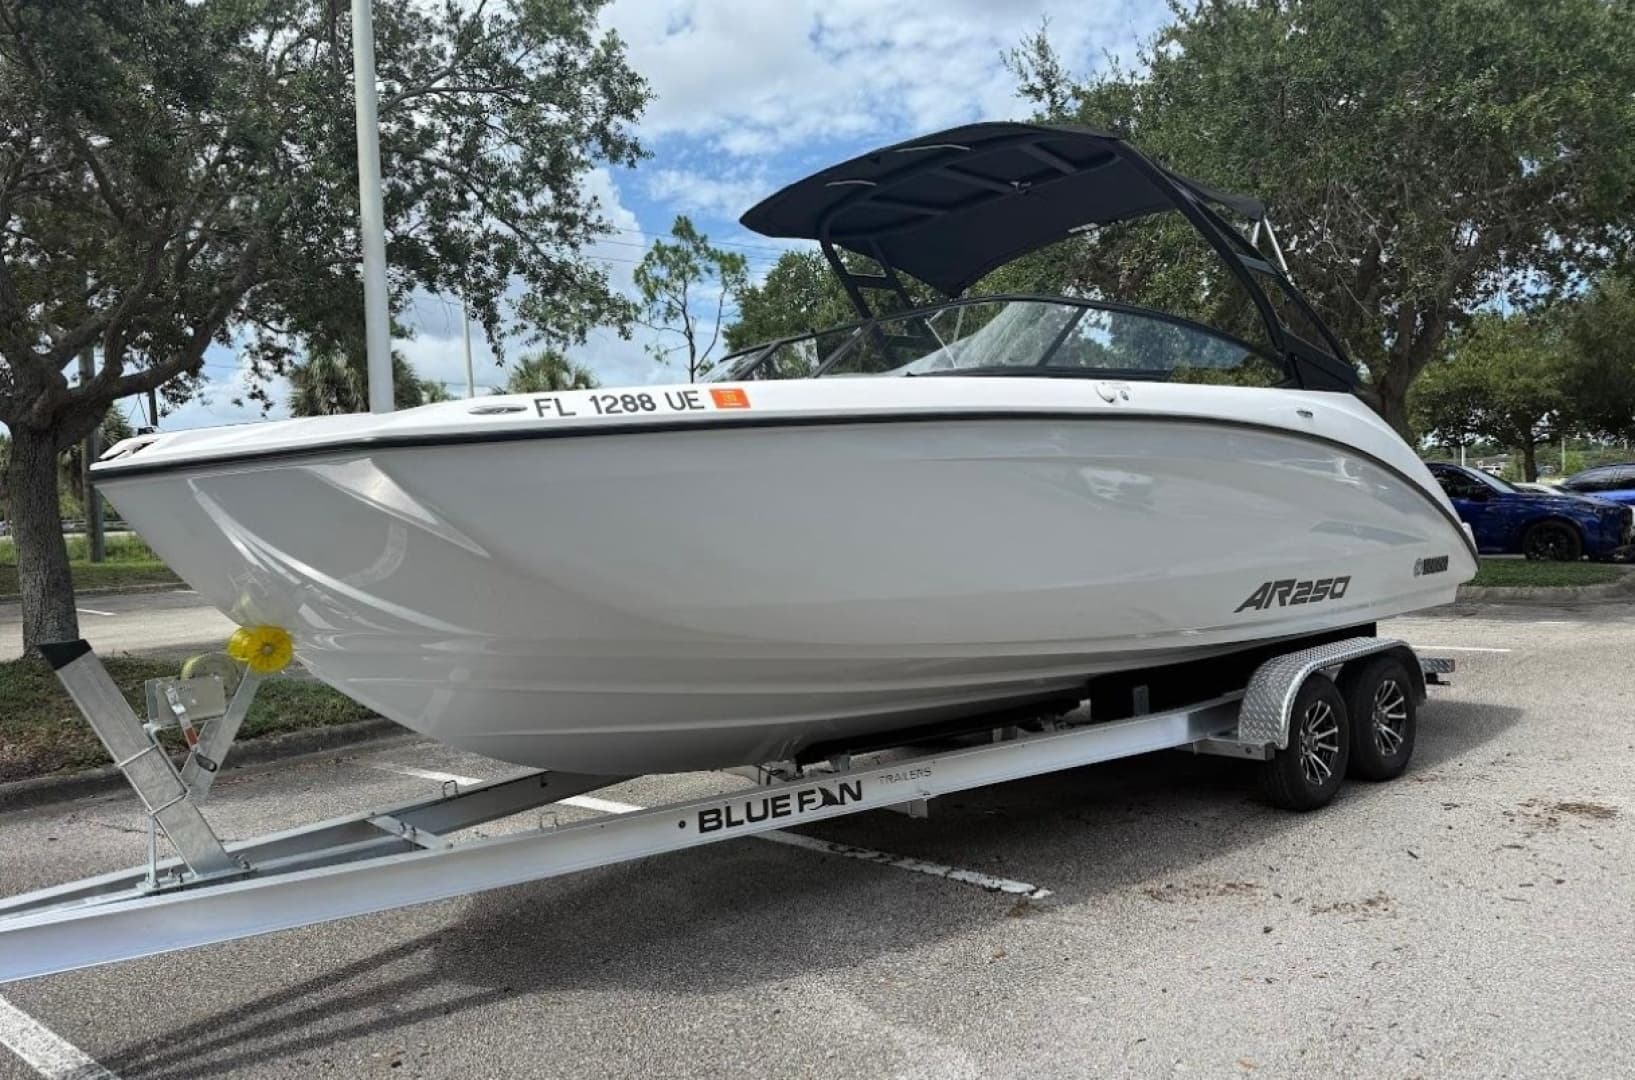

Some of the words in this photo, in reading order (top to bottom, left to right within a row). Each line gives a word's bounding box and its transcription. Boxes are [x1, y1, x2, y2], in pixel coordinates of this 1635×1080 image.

[534, 398, 576, 417] FL
[589, 393, 656, 415] 1288
[665, 390, 704, 411] UE
[1233, 575, 1352, 613] AR250
[879, 766, 933, 785] TRAILERS
